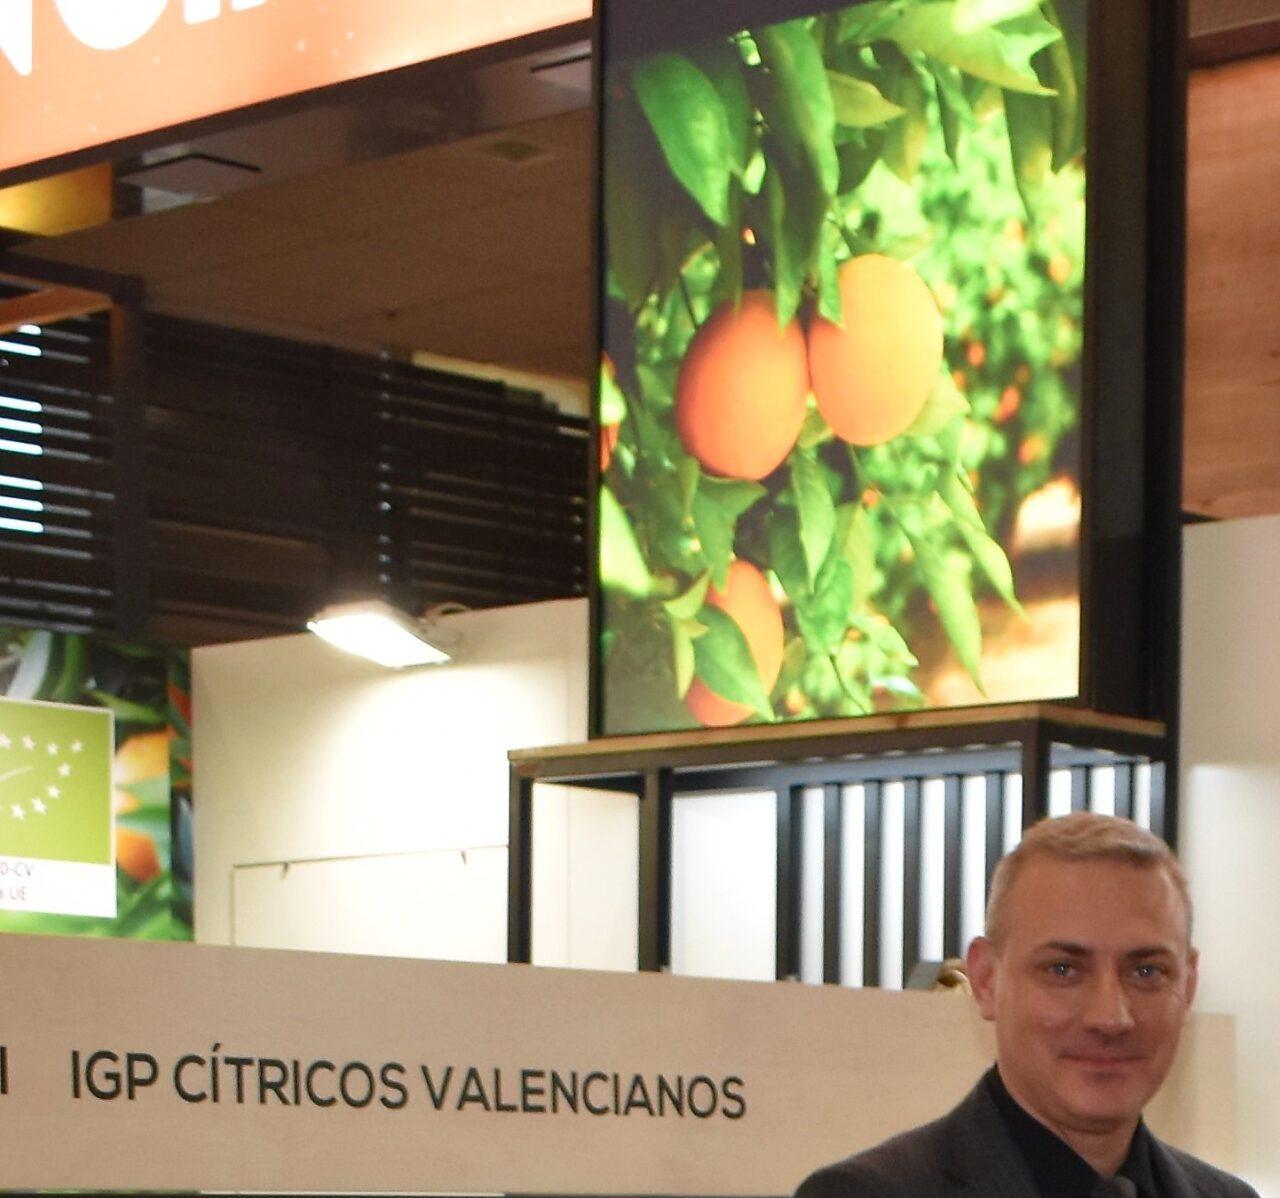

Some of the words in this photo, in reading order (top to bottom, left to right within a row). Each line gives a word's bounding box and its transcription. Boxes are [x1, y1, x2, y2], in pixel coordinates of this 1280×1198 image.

[70, 1050, 158, 1101] IGP
[173, 1042, 410, 1110] CÍTRICOS
[420, 1063, 748, 1121] VALENCIANOS
